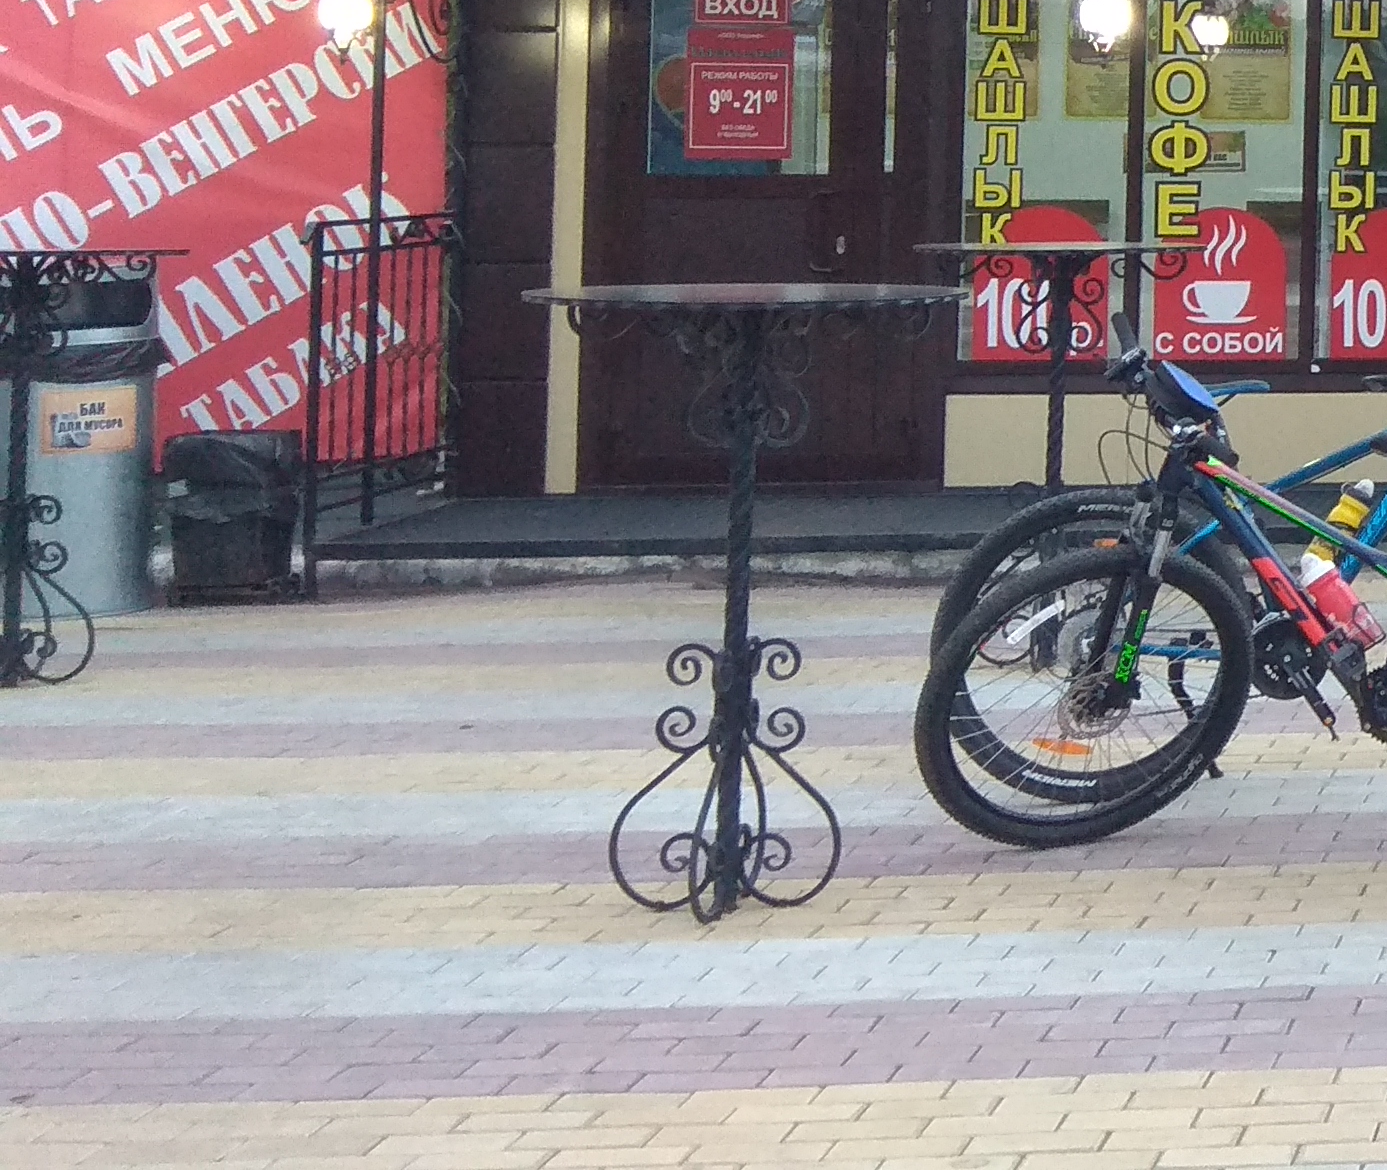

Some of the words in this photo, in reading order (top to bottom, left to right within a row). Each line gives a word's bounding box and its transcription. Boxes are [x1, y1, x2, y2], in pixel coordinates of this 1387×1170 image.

[701, 71, 737, 79] РЕЖИМ
[738, 71, 779, 80] РАБОТЫ
[1155, 334, 1174, 354] С
[1182, 326, 1284, 354] СОБОЙ
